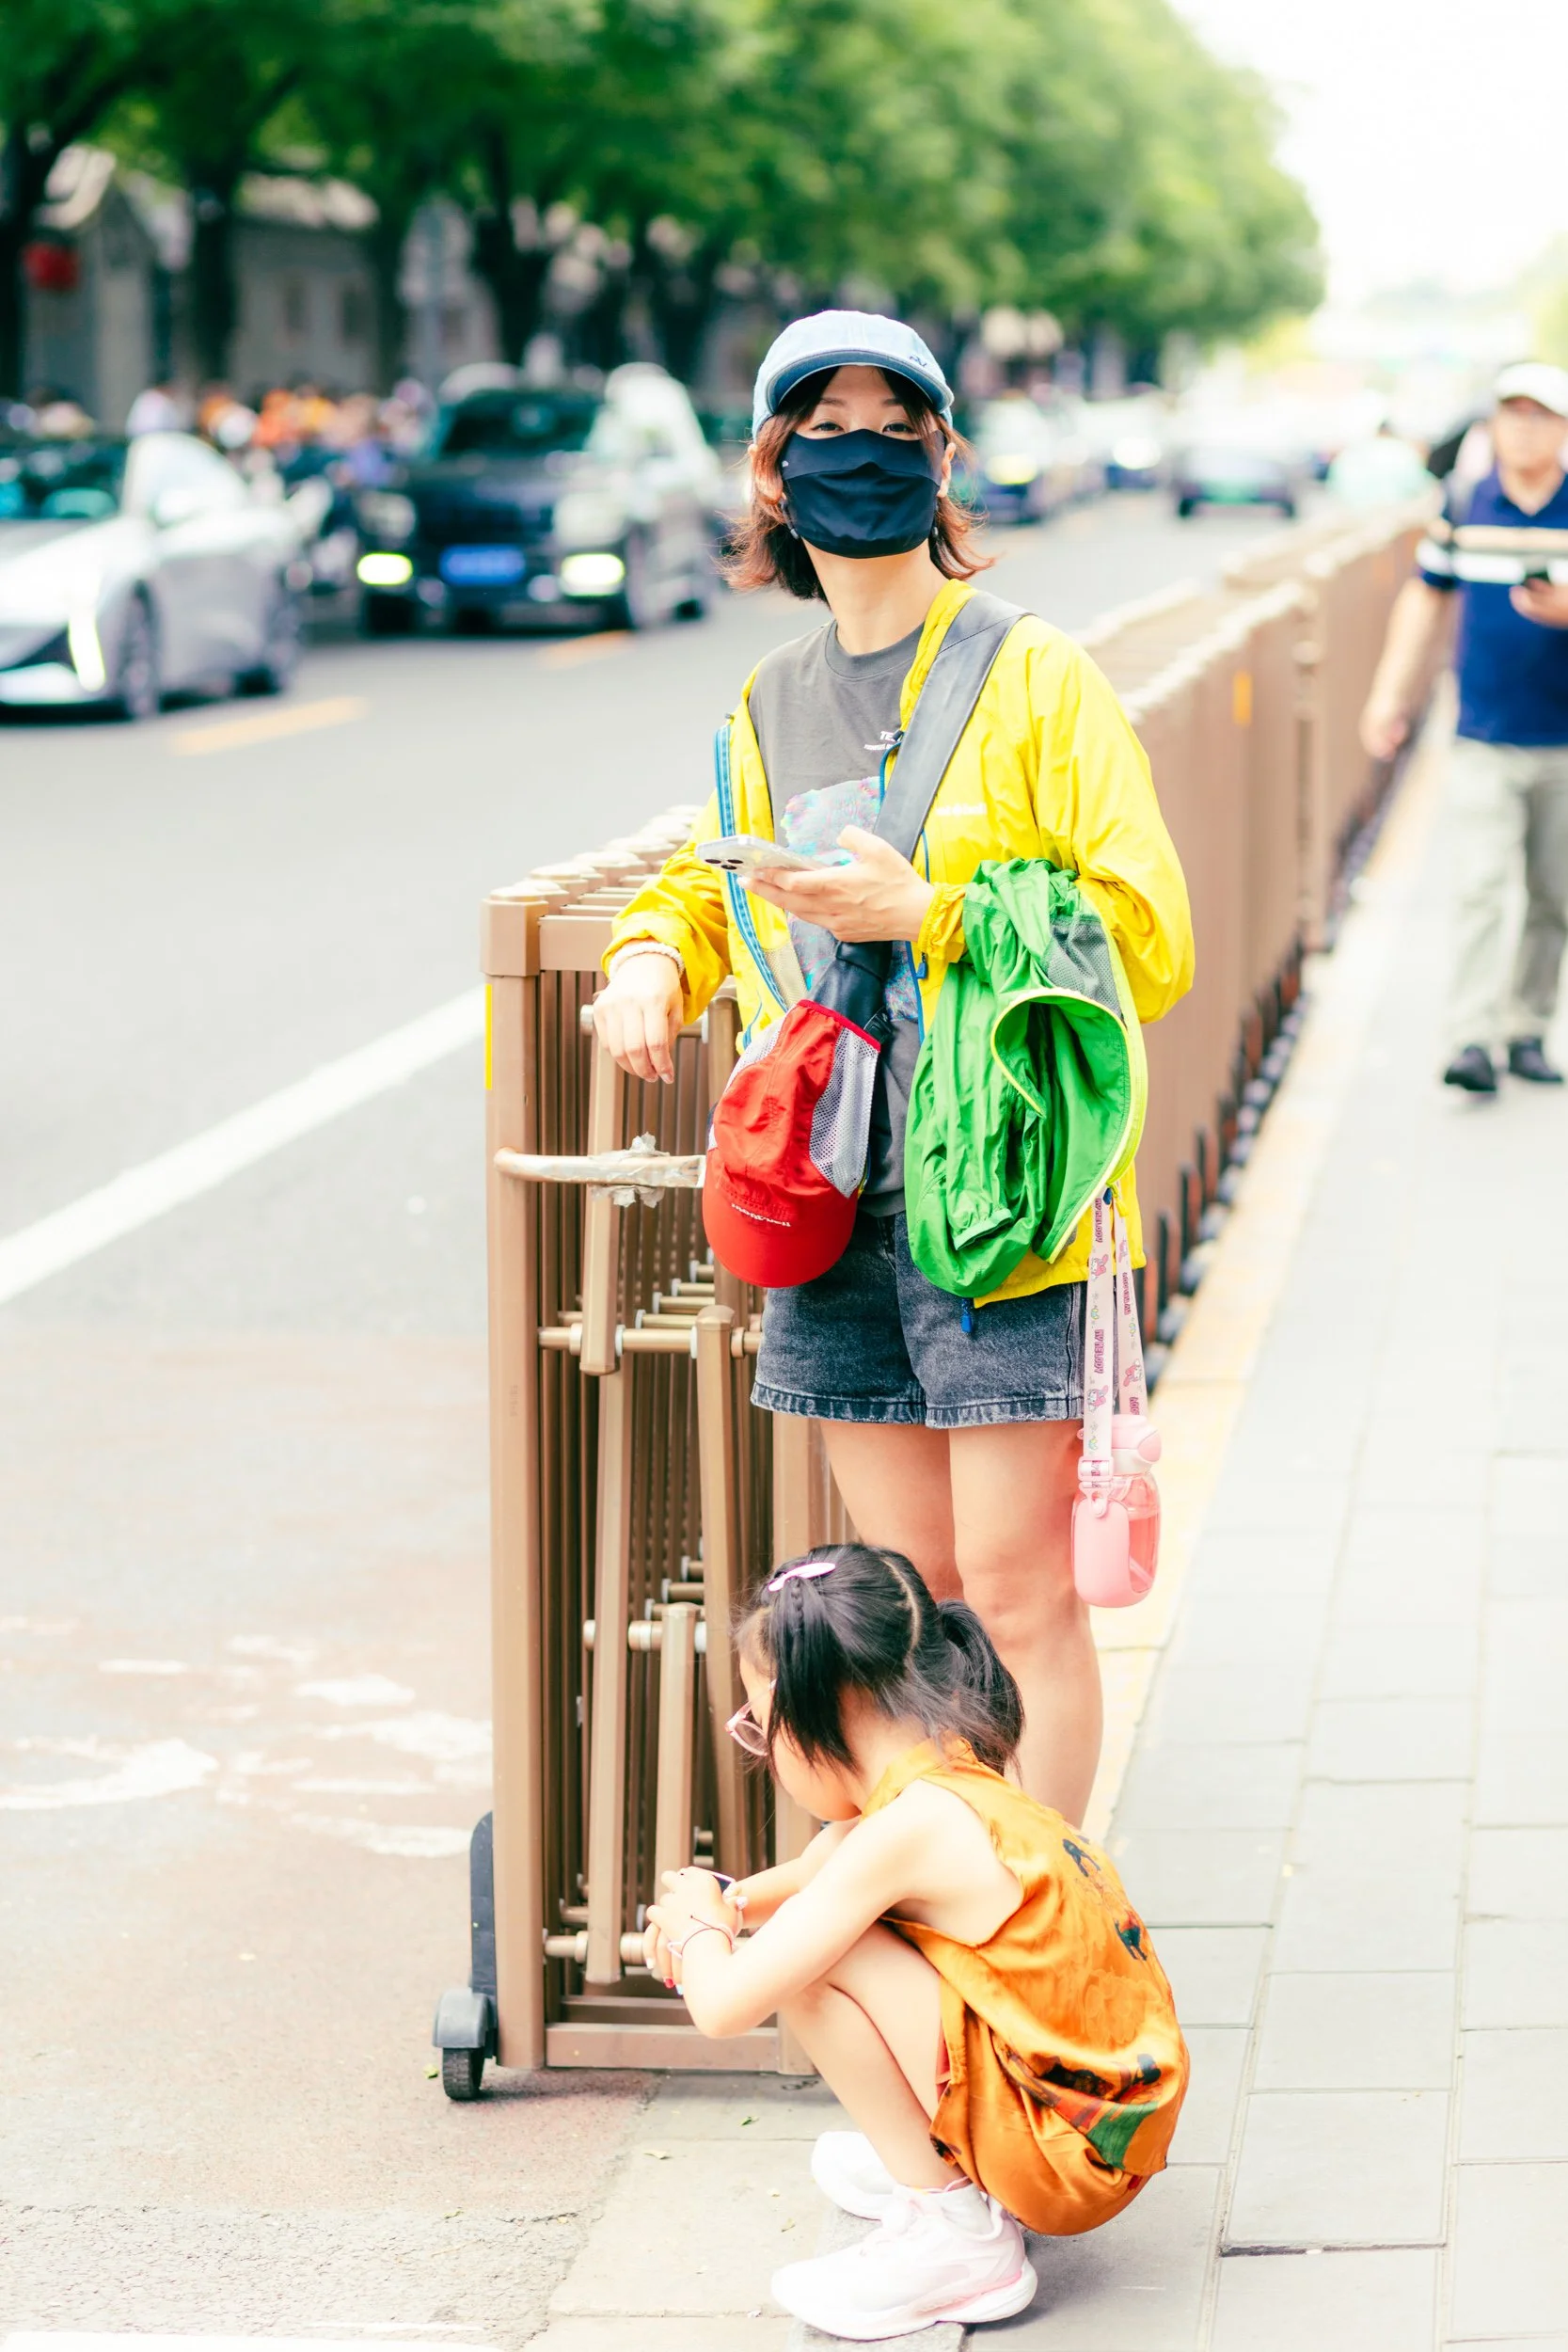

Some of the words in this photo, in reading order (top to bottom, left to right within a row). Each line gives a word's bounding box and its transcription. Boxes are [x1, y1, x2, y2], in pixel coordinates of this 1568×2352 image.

[1095, 1211, 1103, 1243] MELODY
[1094, 1328, 1104, 1342] MY
[1094, 1342, 1104, 1374] MELODY
